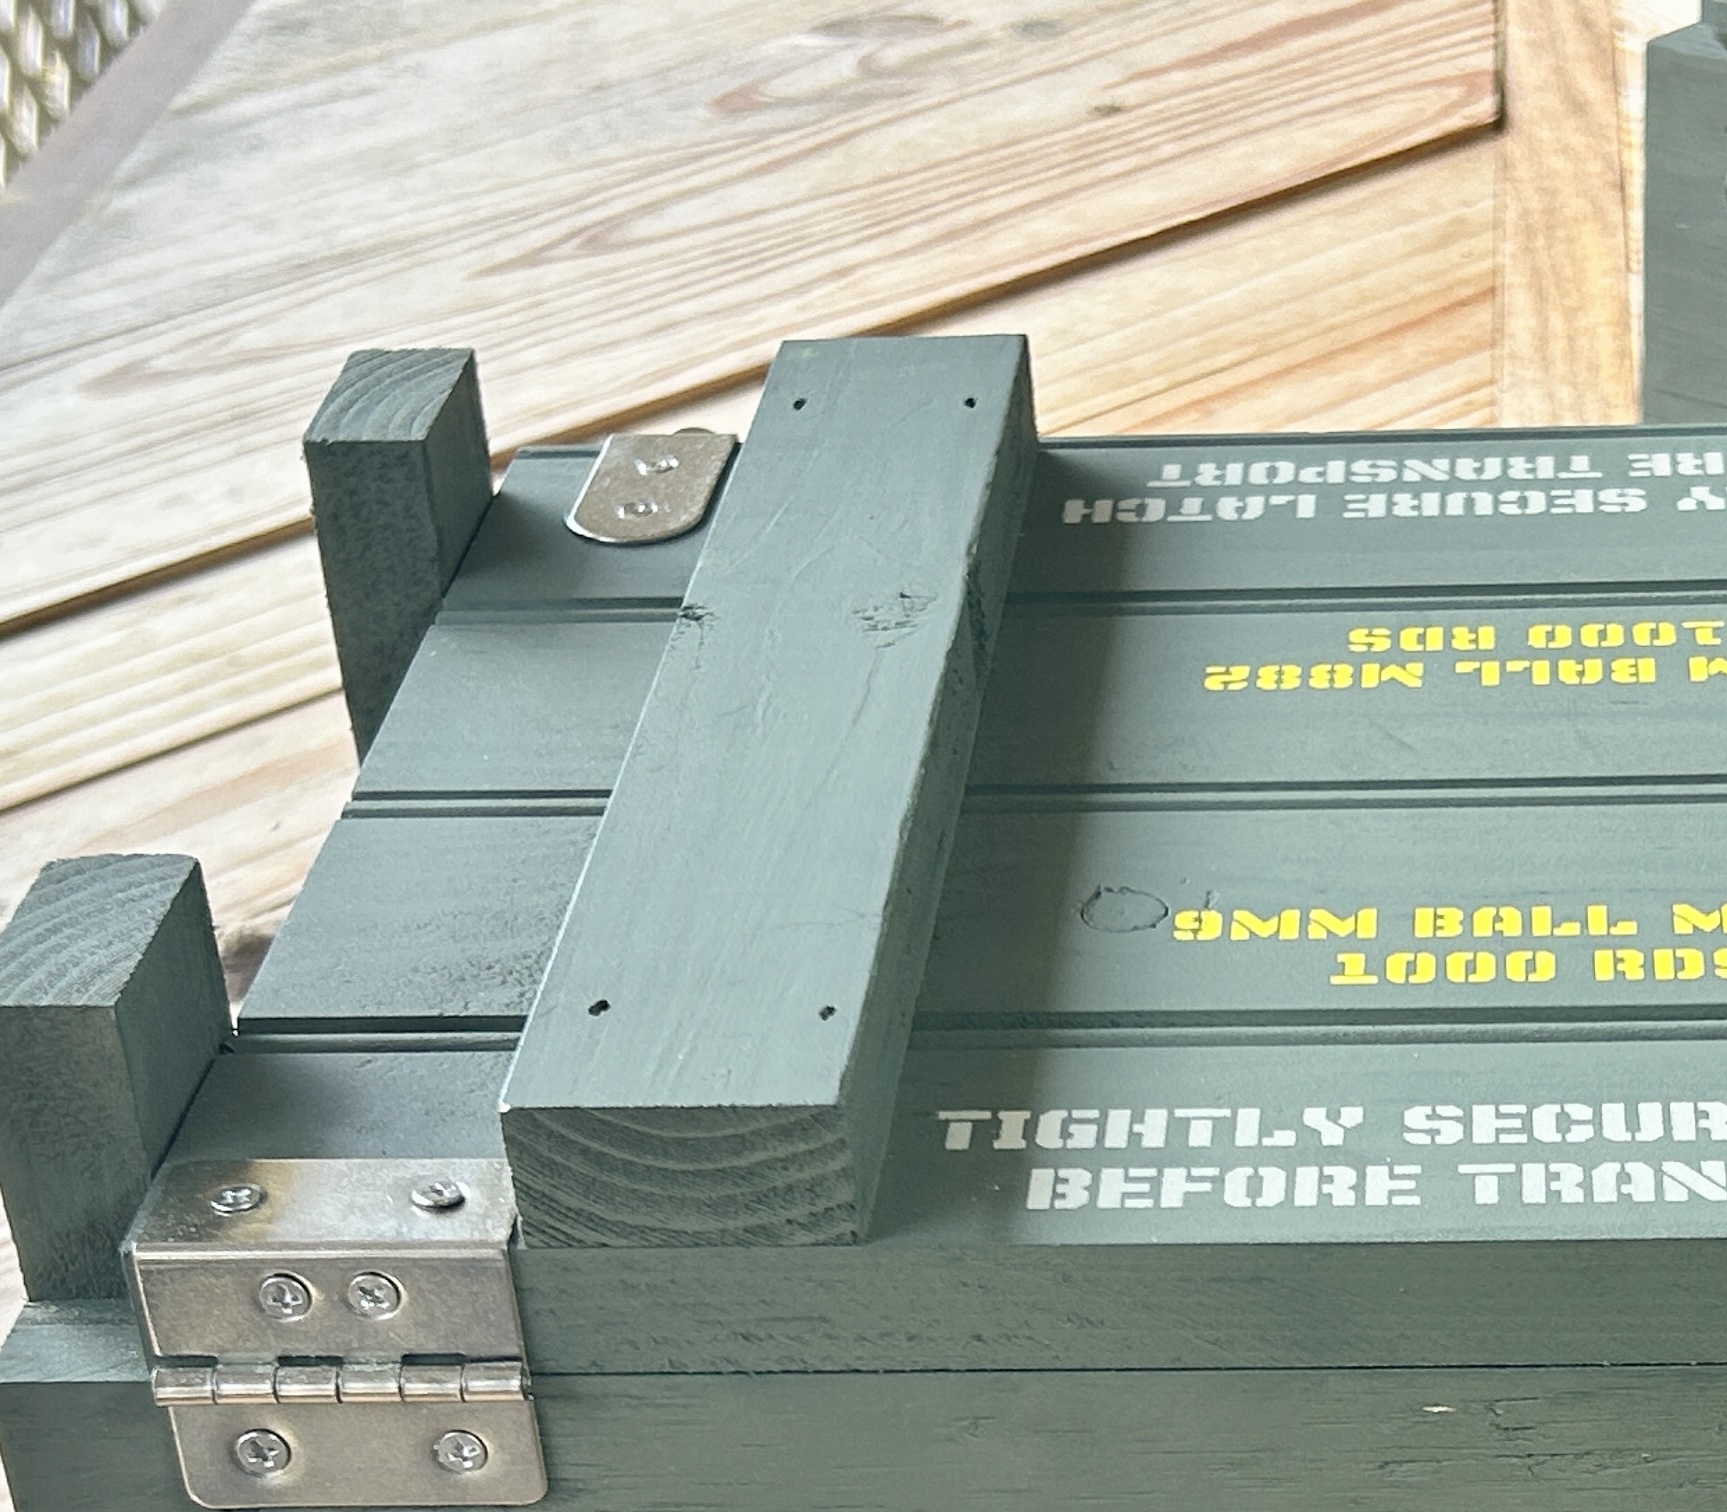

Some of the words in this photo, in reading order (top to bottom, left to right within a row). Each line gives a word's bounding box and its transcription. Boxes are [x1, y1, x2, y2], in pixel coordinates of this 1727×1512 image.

[1146, 455, 1603, 487] TRANSPORT
[1062, 493, 1317, 524] LATCH
[1342, 484, 1647, 518] SECURE
[1348, 624, 1496, 652] RDS
[1529, 620, 1727, 649] 1000
[1203, 661, 1424, 691] M882
[1455, 656, 1657, 687] BALL
[1173, 906, 1379, 941] 9MM
[1412, 904, 1637, 937] BALL
[1329, 950, 1556, 985] 1000
[937, 1106, 1365, 1150] TIGHTLY
[1026, 1163, 1423, 1210] BEFORE
